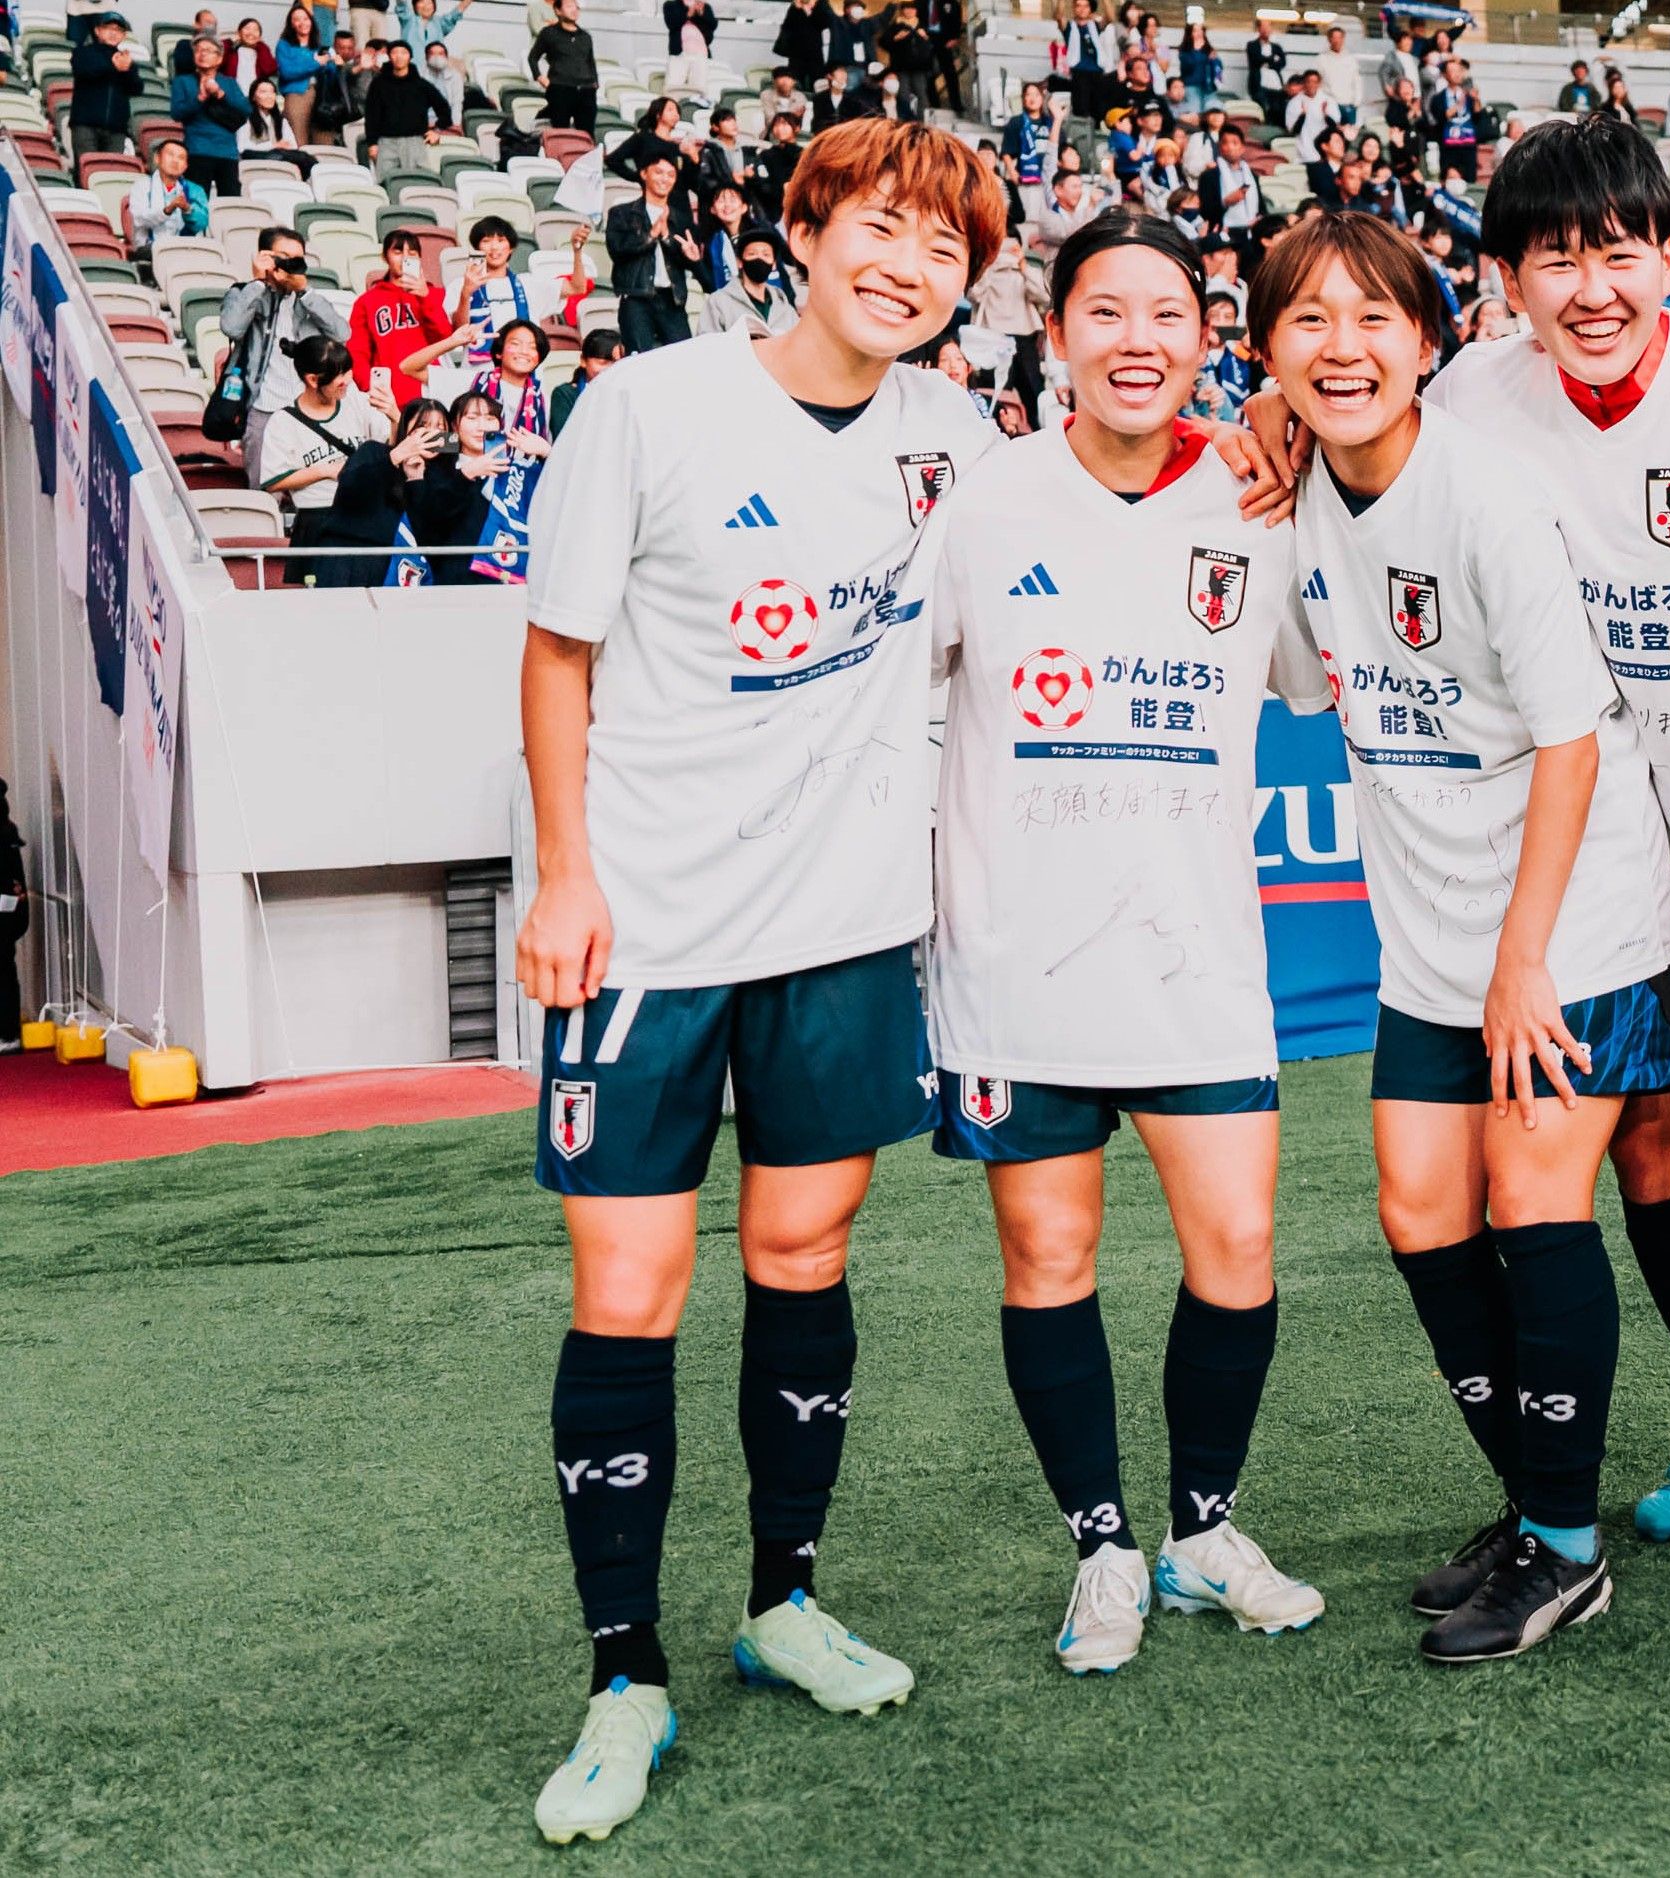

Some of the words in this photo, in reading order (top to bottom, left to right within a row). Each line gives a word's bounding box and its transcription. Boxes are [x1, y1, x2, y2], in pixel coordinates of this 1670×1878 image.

[908, 452, 939, 463] JAPAN
[1204, 550, 1238, 564] JAPAN
[1398, 570, 1427, 584] JAPAN
[1202, 605, 1226, 622] JFA
[1402, 625, 1428, 641] JFA
[1101, 655, 1225, 695] がんばろう
[557, 1452, 650, 1495] Y-3
[1063, 1501, 1123, 1541] Y-3
